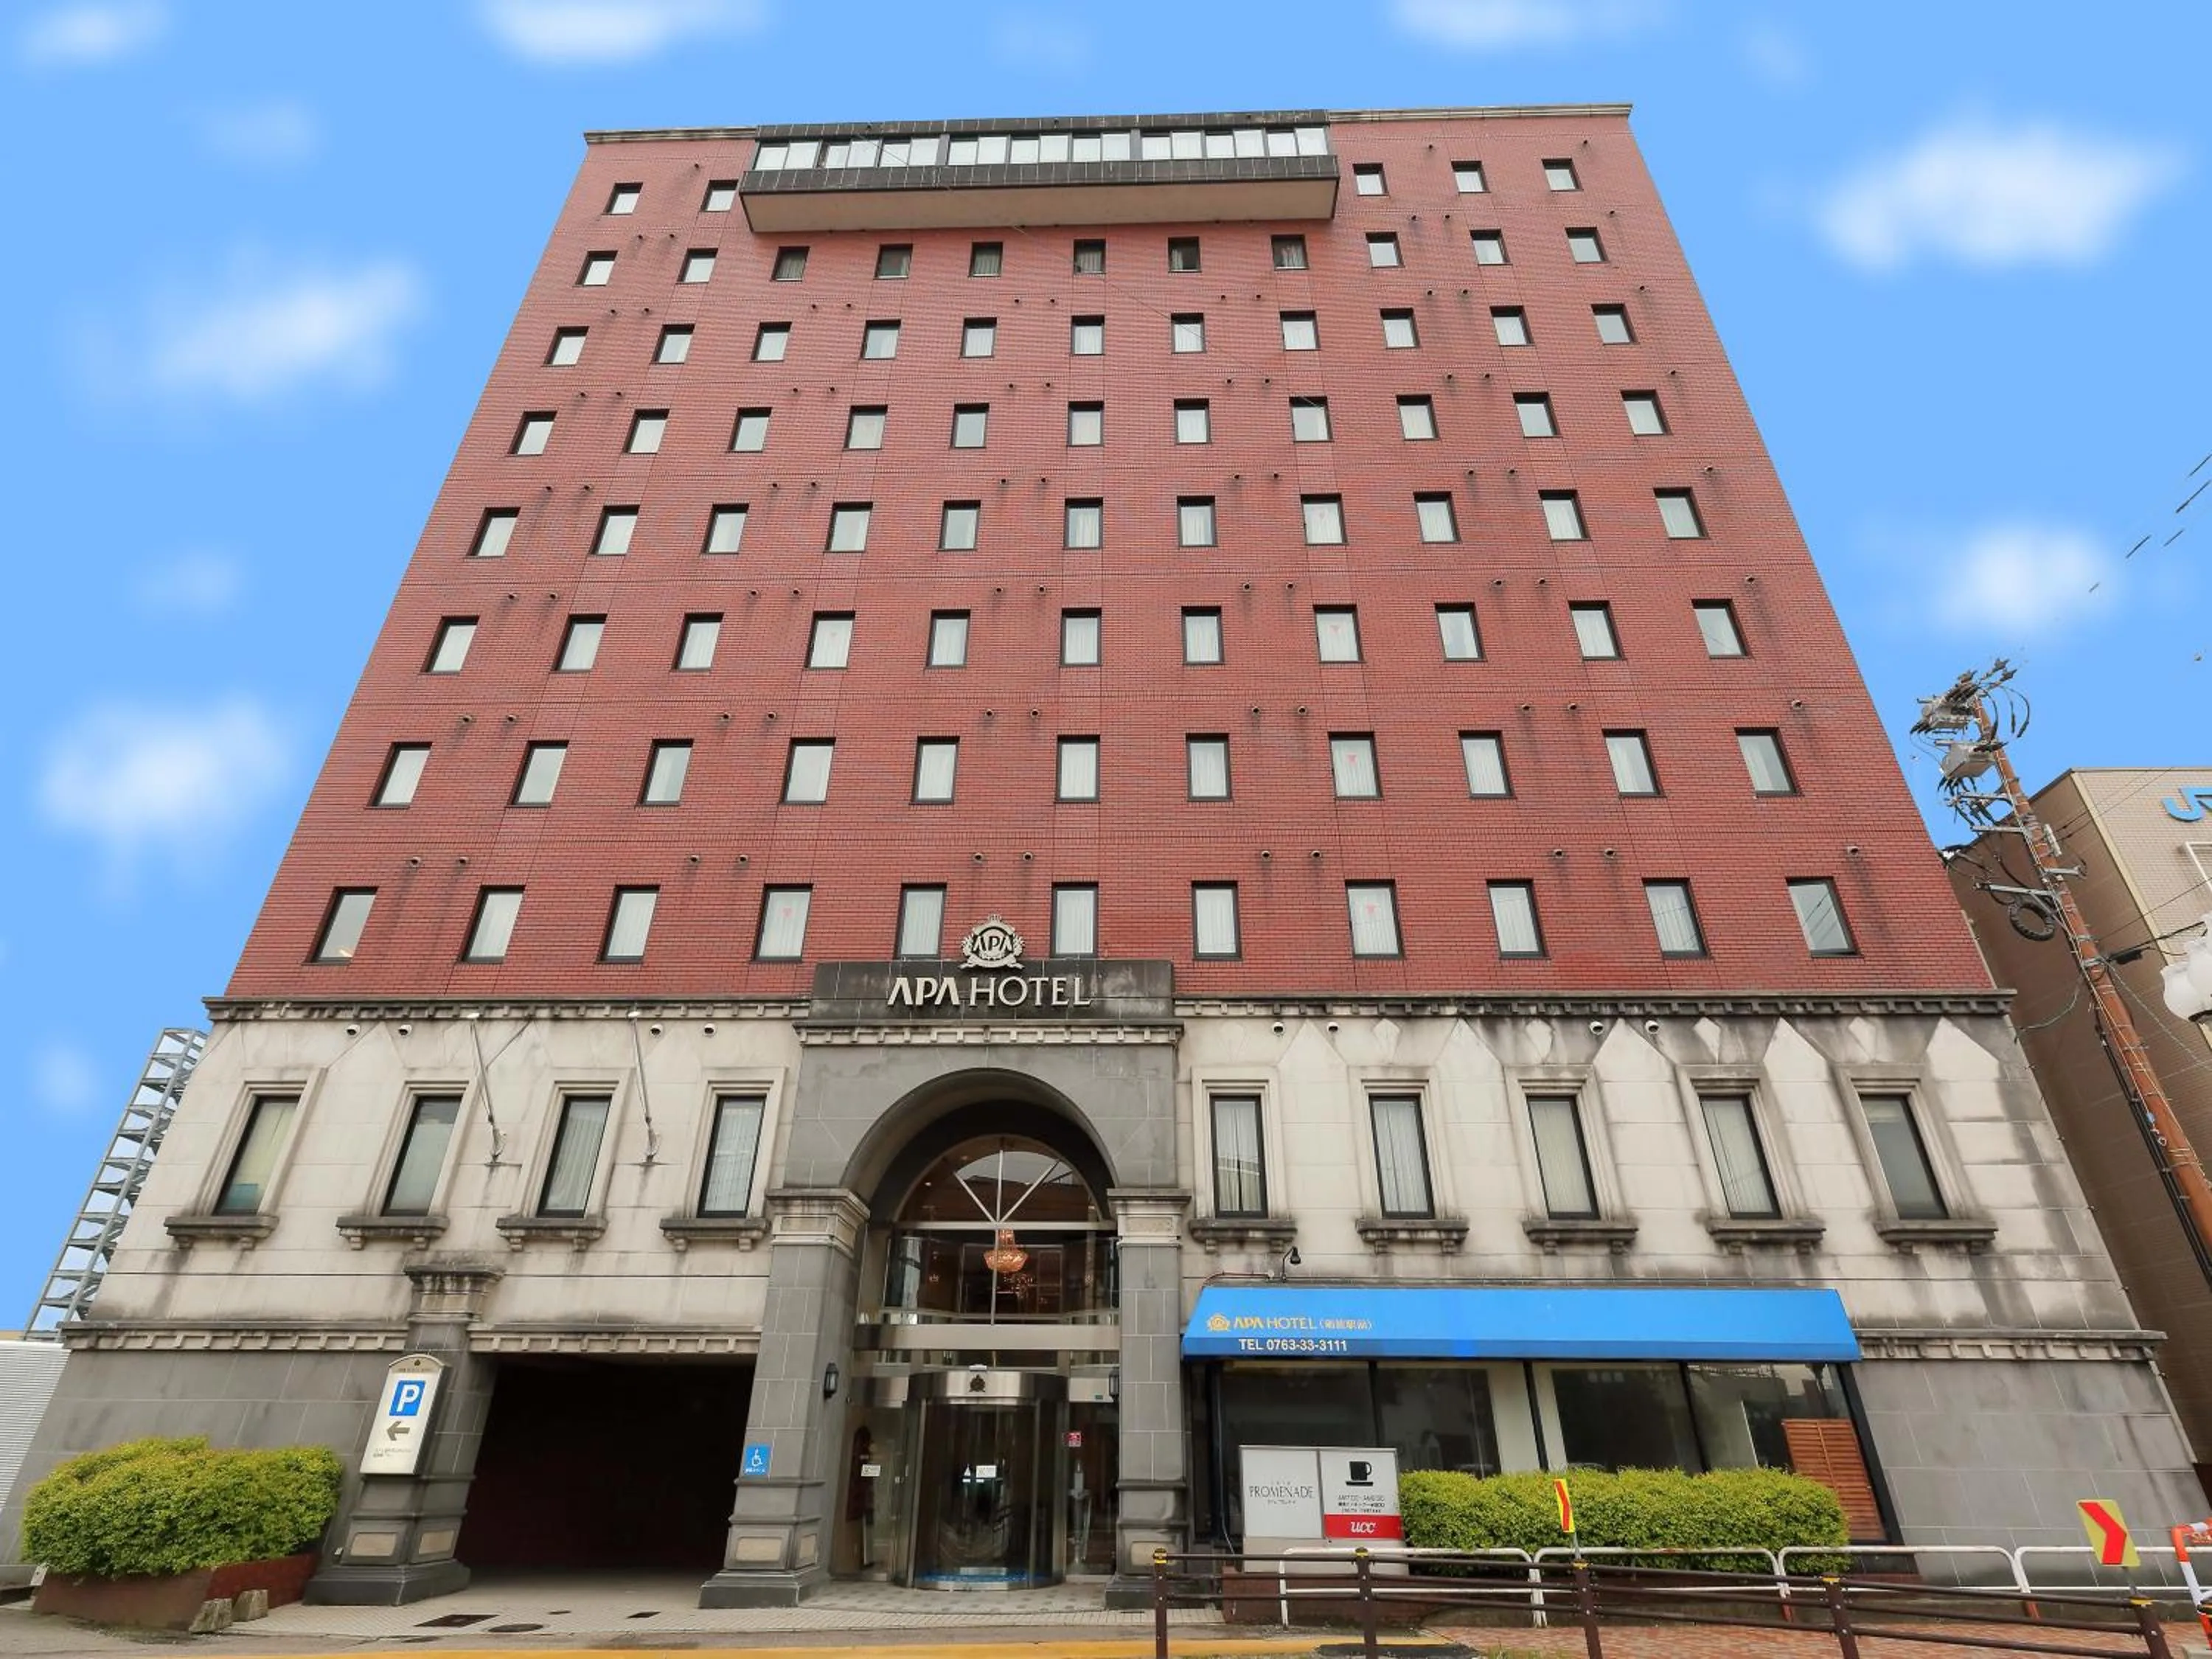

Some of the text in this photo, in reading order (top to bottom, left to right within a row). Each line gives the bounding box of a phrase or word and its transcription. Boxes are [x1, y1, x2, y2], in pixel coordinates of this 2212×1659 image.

[971, 935, 1015, 952] APA
[887, 975, 1091, 1006] APA HOTEL
[1234, 1316, 1265, 1329] APA
[1267, 1317, 1317, 1330] HOTEL
[1238, 1338, 1348, 1352] TEL 0763-33-3111
[397, 1384, 420, 1412] P
[1249, 1486, 1315, 1499] PROMENADE
